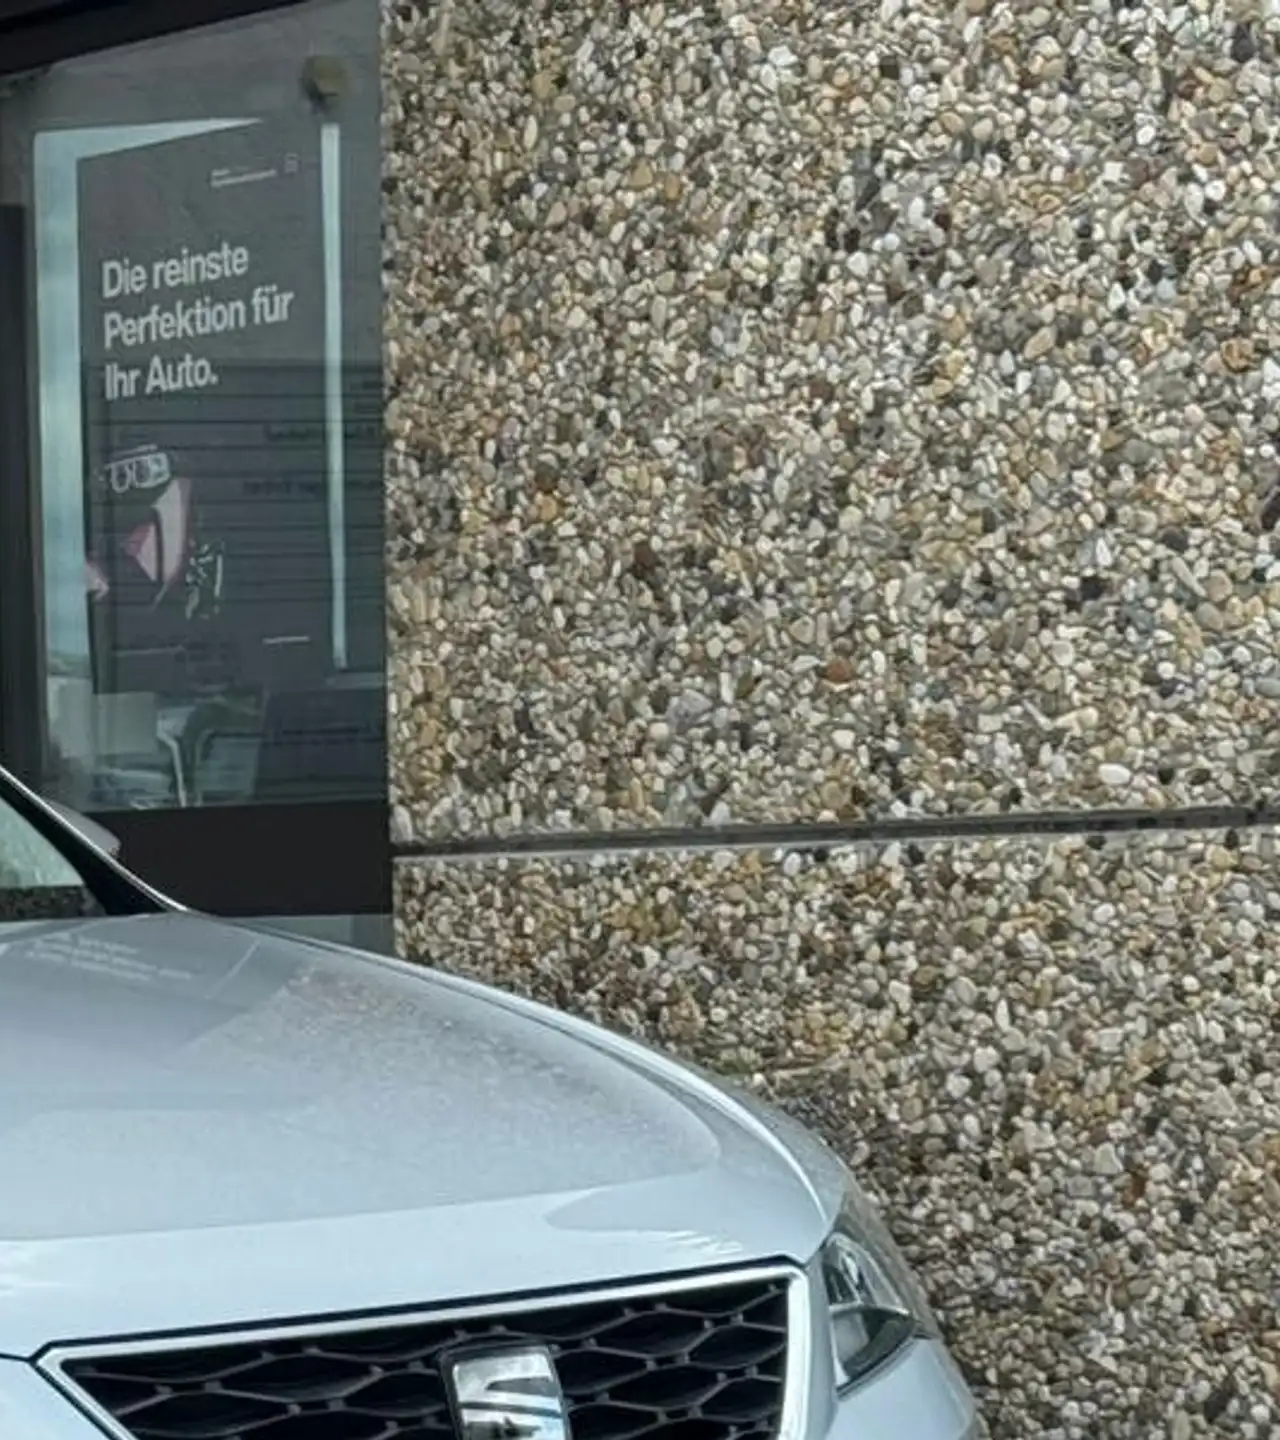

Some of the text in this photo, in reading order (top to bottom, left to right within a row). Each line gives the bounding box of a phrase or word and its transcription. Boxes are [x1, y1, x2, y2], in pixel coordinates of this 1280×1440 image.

[102, 241, 249, 298] Die reinste
[104, 283, 295, 350] Perfektion für
[104, 352, 219, 401] Ihr Auto.
